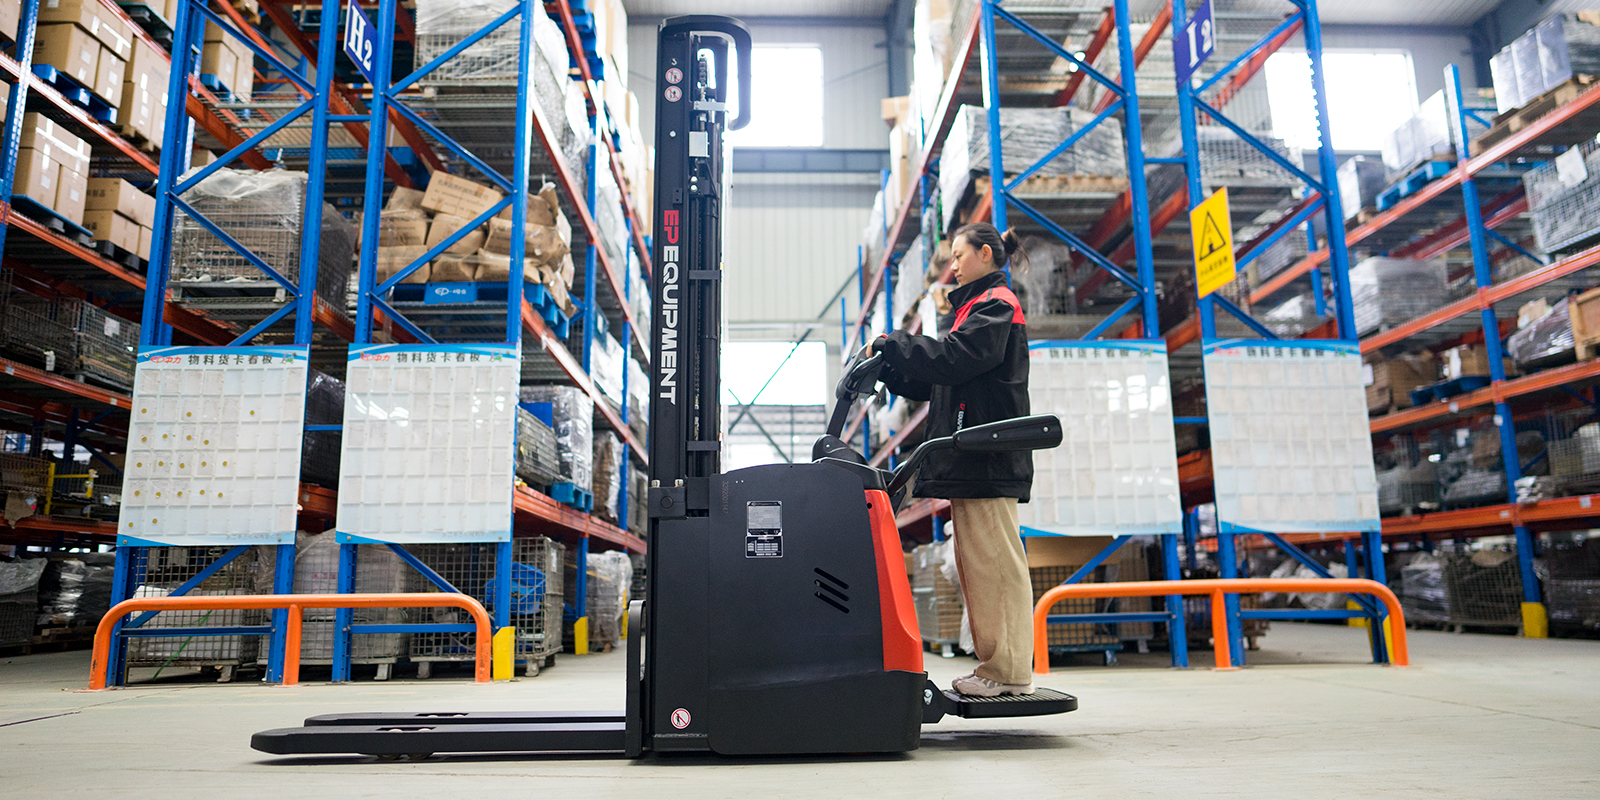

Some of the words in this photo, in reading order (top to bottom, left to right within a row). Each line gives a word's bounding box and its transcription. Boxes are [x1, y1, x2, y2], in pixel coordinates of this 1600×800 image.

[348, 5, 373, 72] H2
[664, 210, 679, 244] EP
[659, 245, 679, 405] EQUIPMENT
[188, 354, 273, 365] 物料货卡看板
[396, 352, 481, 363] 物料货卡看板
